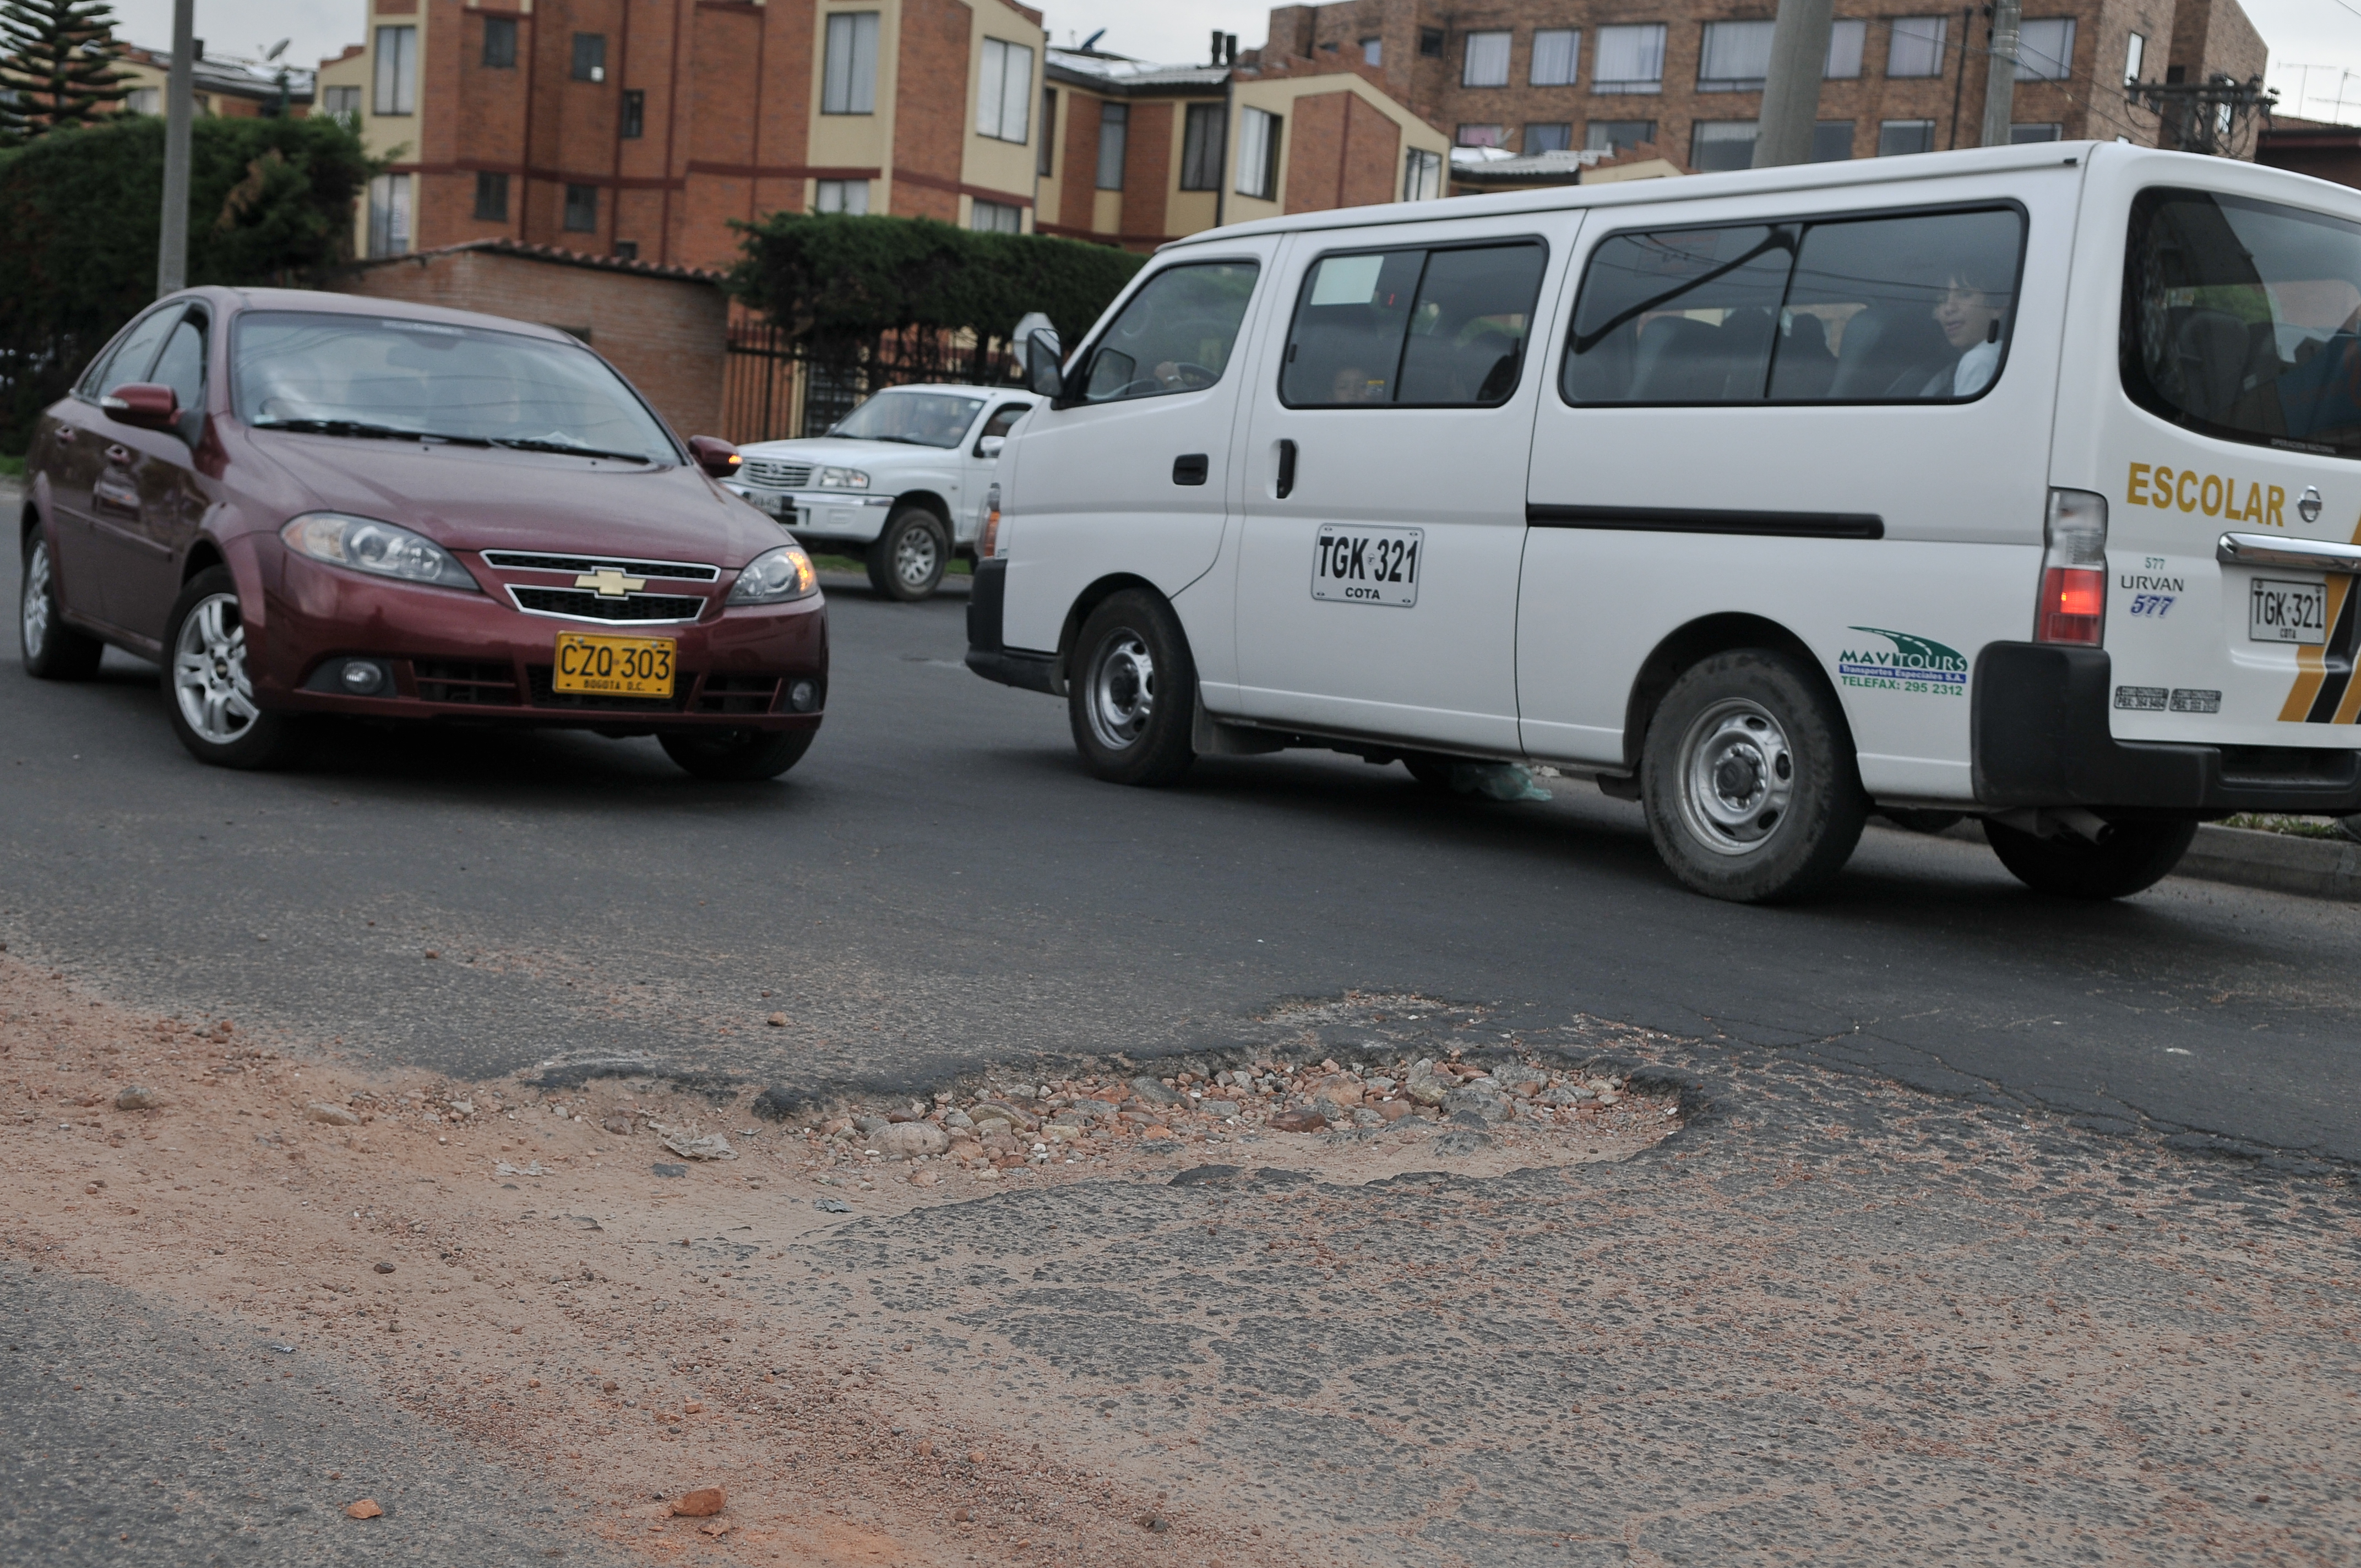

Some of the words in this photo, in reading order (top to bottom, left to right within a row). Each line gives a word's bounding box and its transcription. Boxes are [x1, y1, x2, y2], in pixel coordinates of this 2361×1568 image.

[2126, 461, 2285, 527] ESCOLAR
[1319, 536, 1369, 580] TGK
[1374, 538, 1418, 584] 321
[2145, 557, 2165, 569] 577
[1345, 586, 1381, 600] COTA
[2121, 575, 2184, 592] URVAN
[2130, 592, 2176, 617] 577
[2254, 590, 2287, 626] TGK
[2292, 594, 2322, 629] 321
[561, 644, 612, 677] CZQ
[620, 648, 671, 680] 303
[1839, 650, 1966, 672] MAVITOURS
[1842, 665, 1893, 676] Transportes
[1895, 668, 1943, 680] Especiales
[1945, 673, 1965, 683] S.A.
[1841, 676, 1900, 690] TELEFAX:
[1905, 681, 1928, 693] 295
[1932, 683, 1963, 696] 2312
